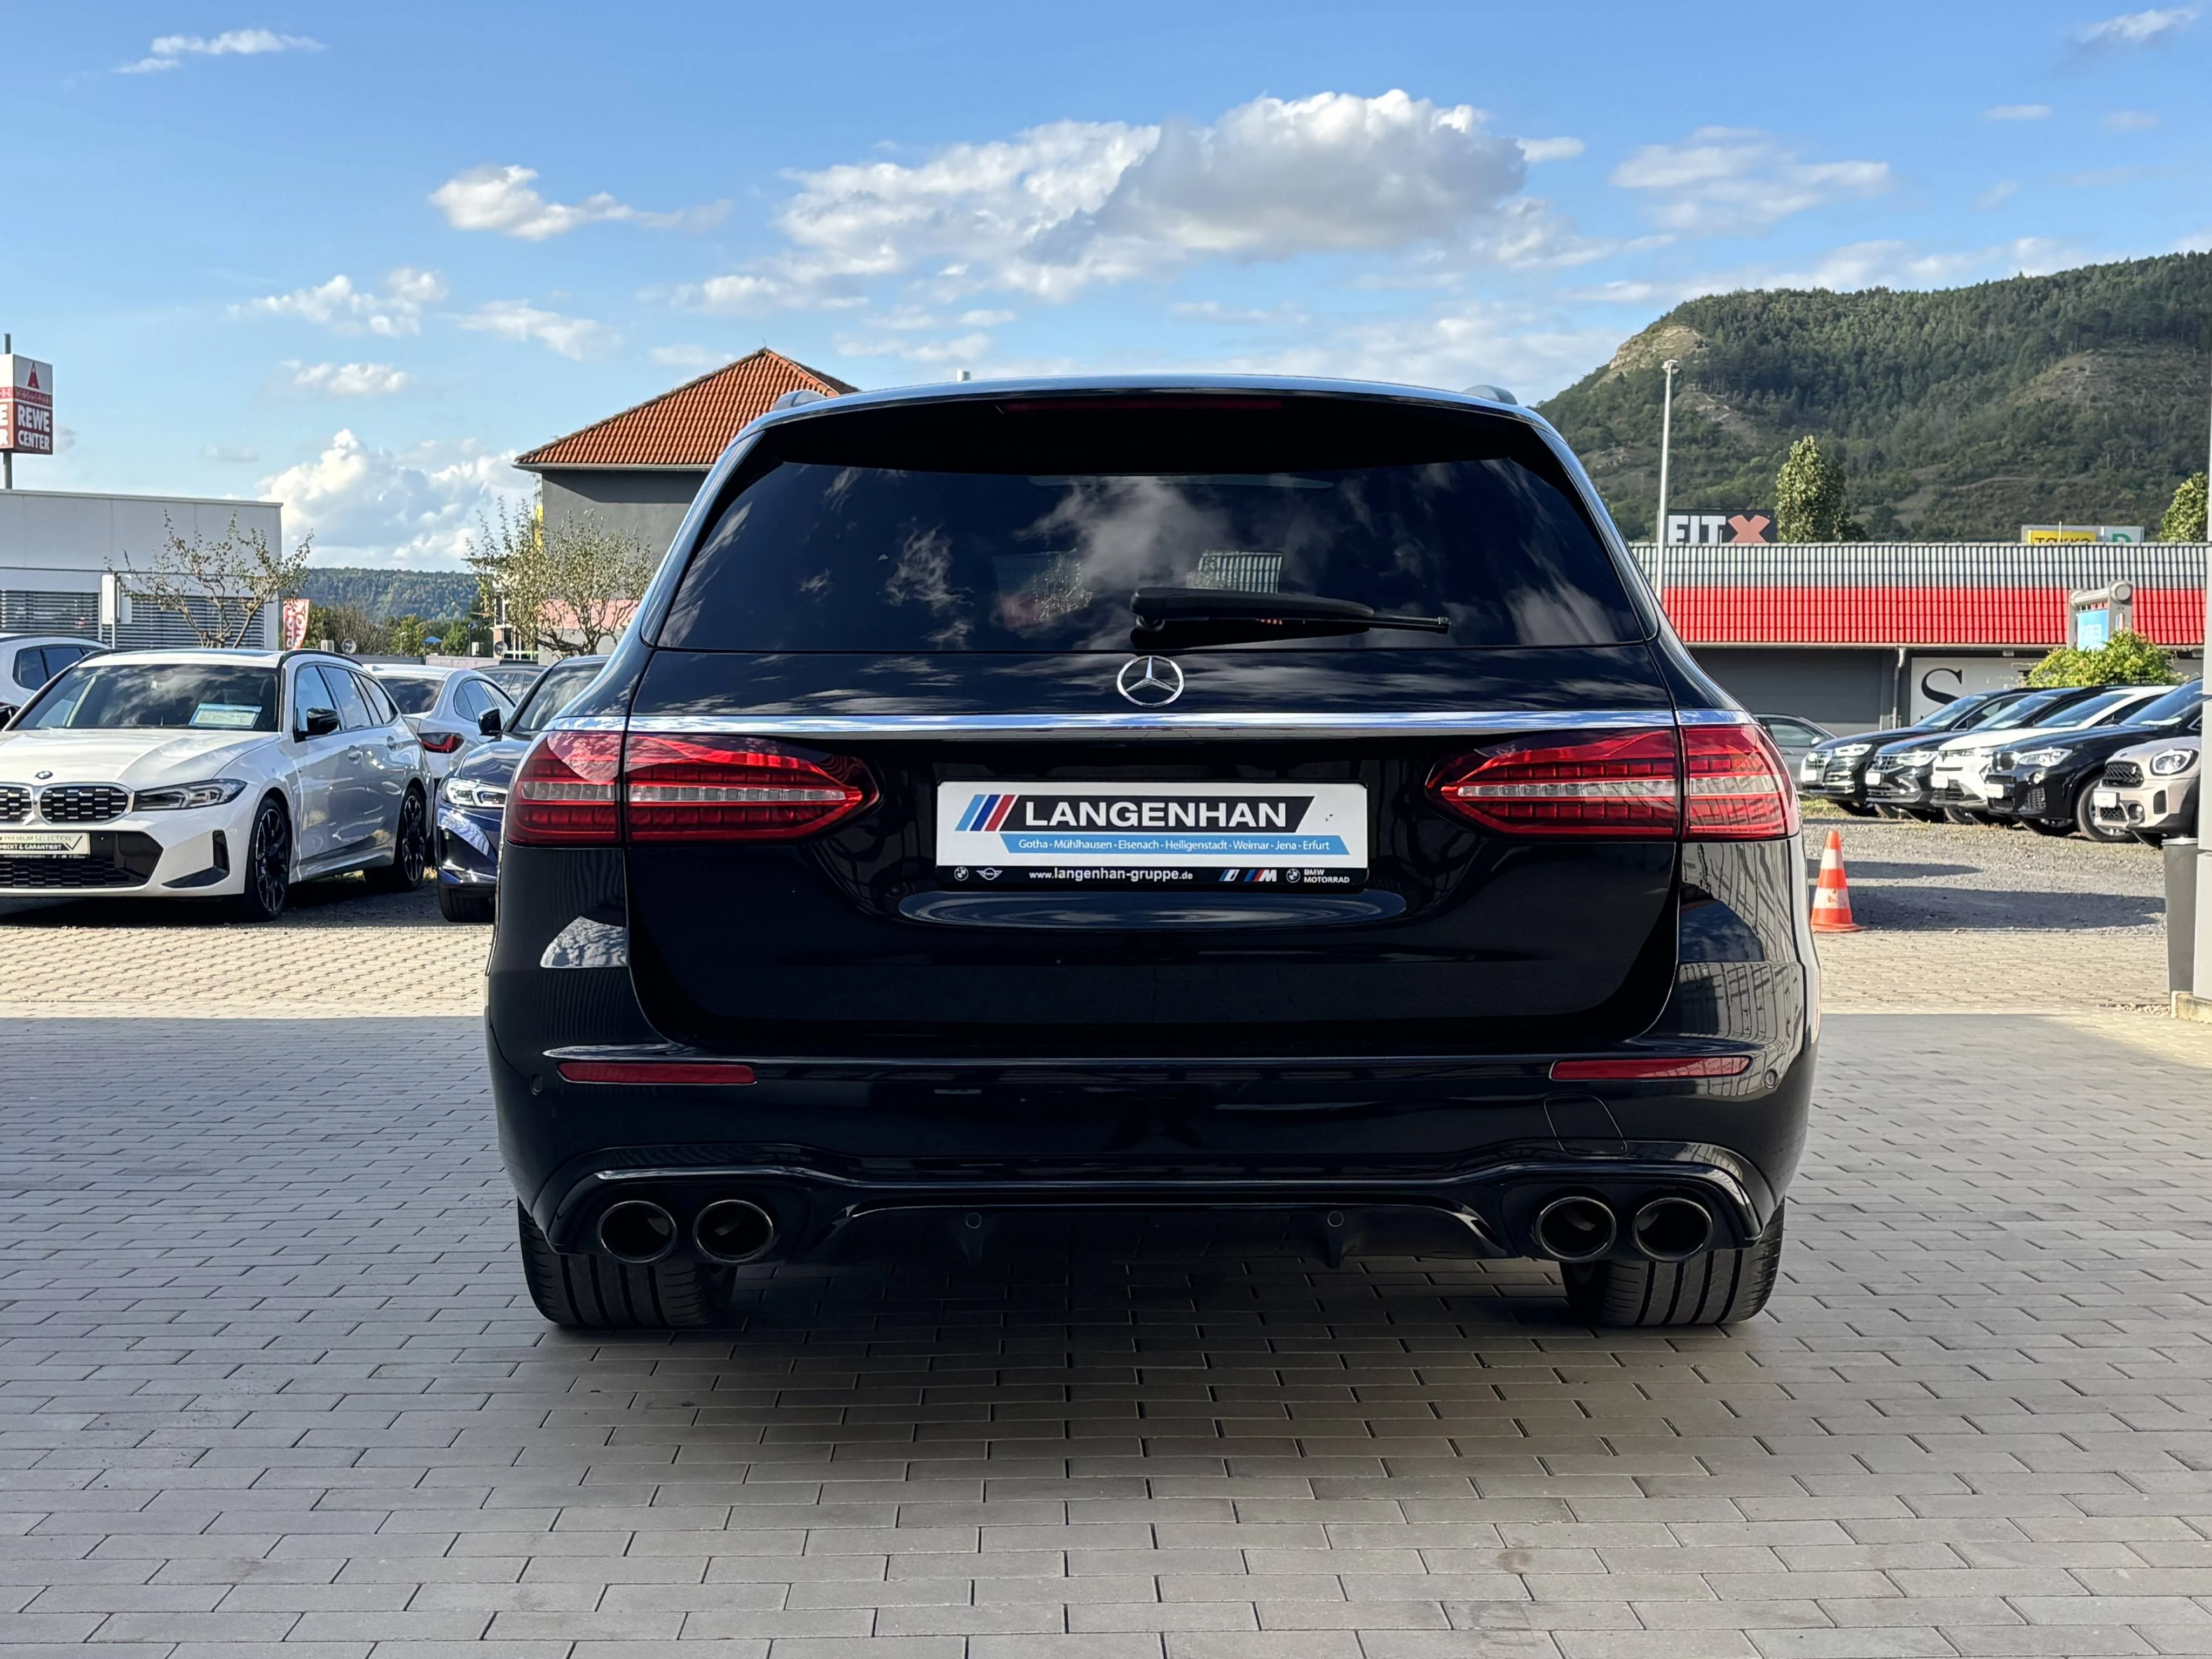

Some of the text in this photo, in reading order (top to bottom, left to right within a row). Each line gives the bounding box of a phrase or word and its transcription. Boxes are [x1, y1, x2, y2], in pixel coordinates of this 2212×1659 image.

[18, 404, 50, 433] REWE
[18, 430, 50, 451] CENTER
[1025, 801, 1287, 827] LANGENHAN
[1019, 839, 1330, 852] Gotha Mühlhausen Eisenach Heiligenstadt Weimar Jena Erfurt
[1029, 867, 1193, 882] www.langenhan-gruppe.de
